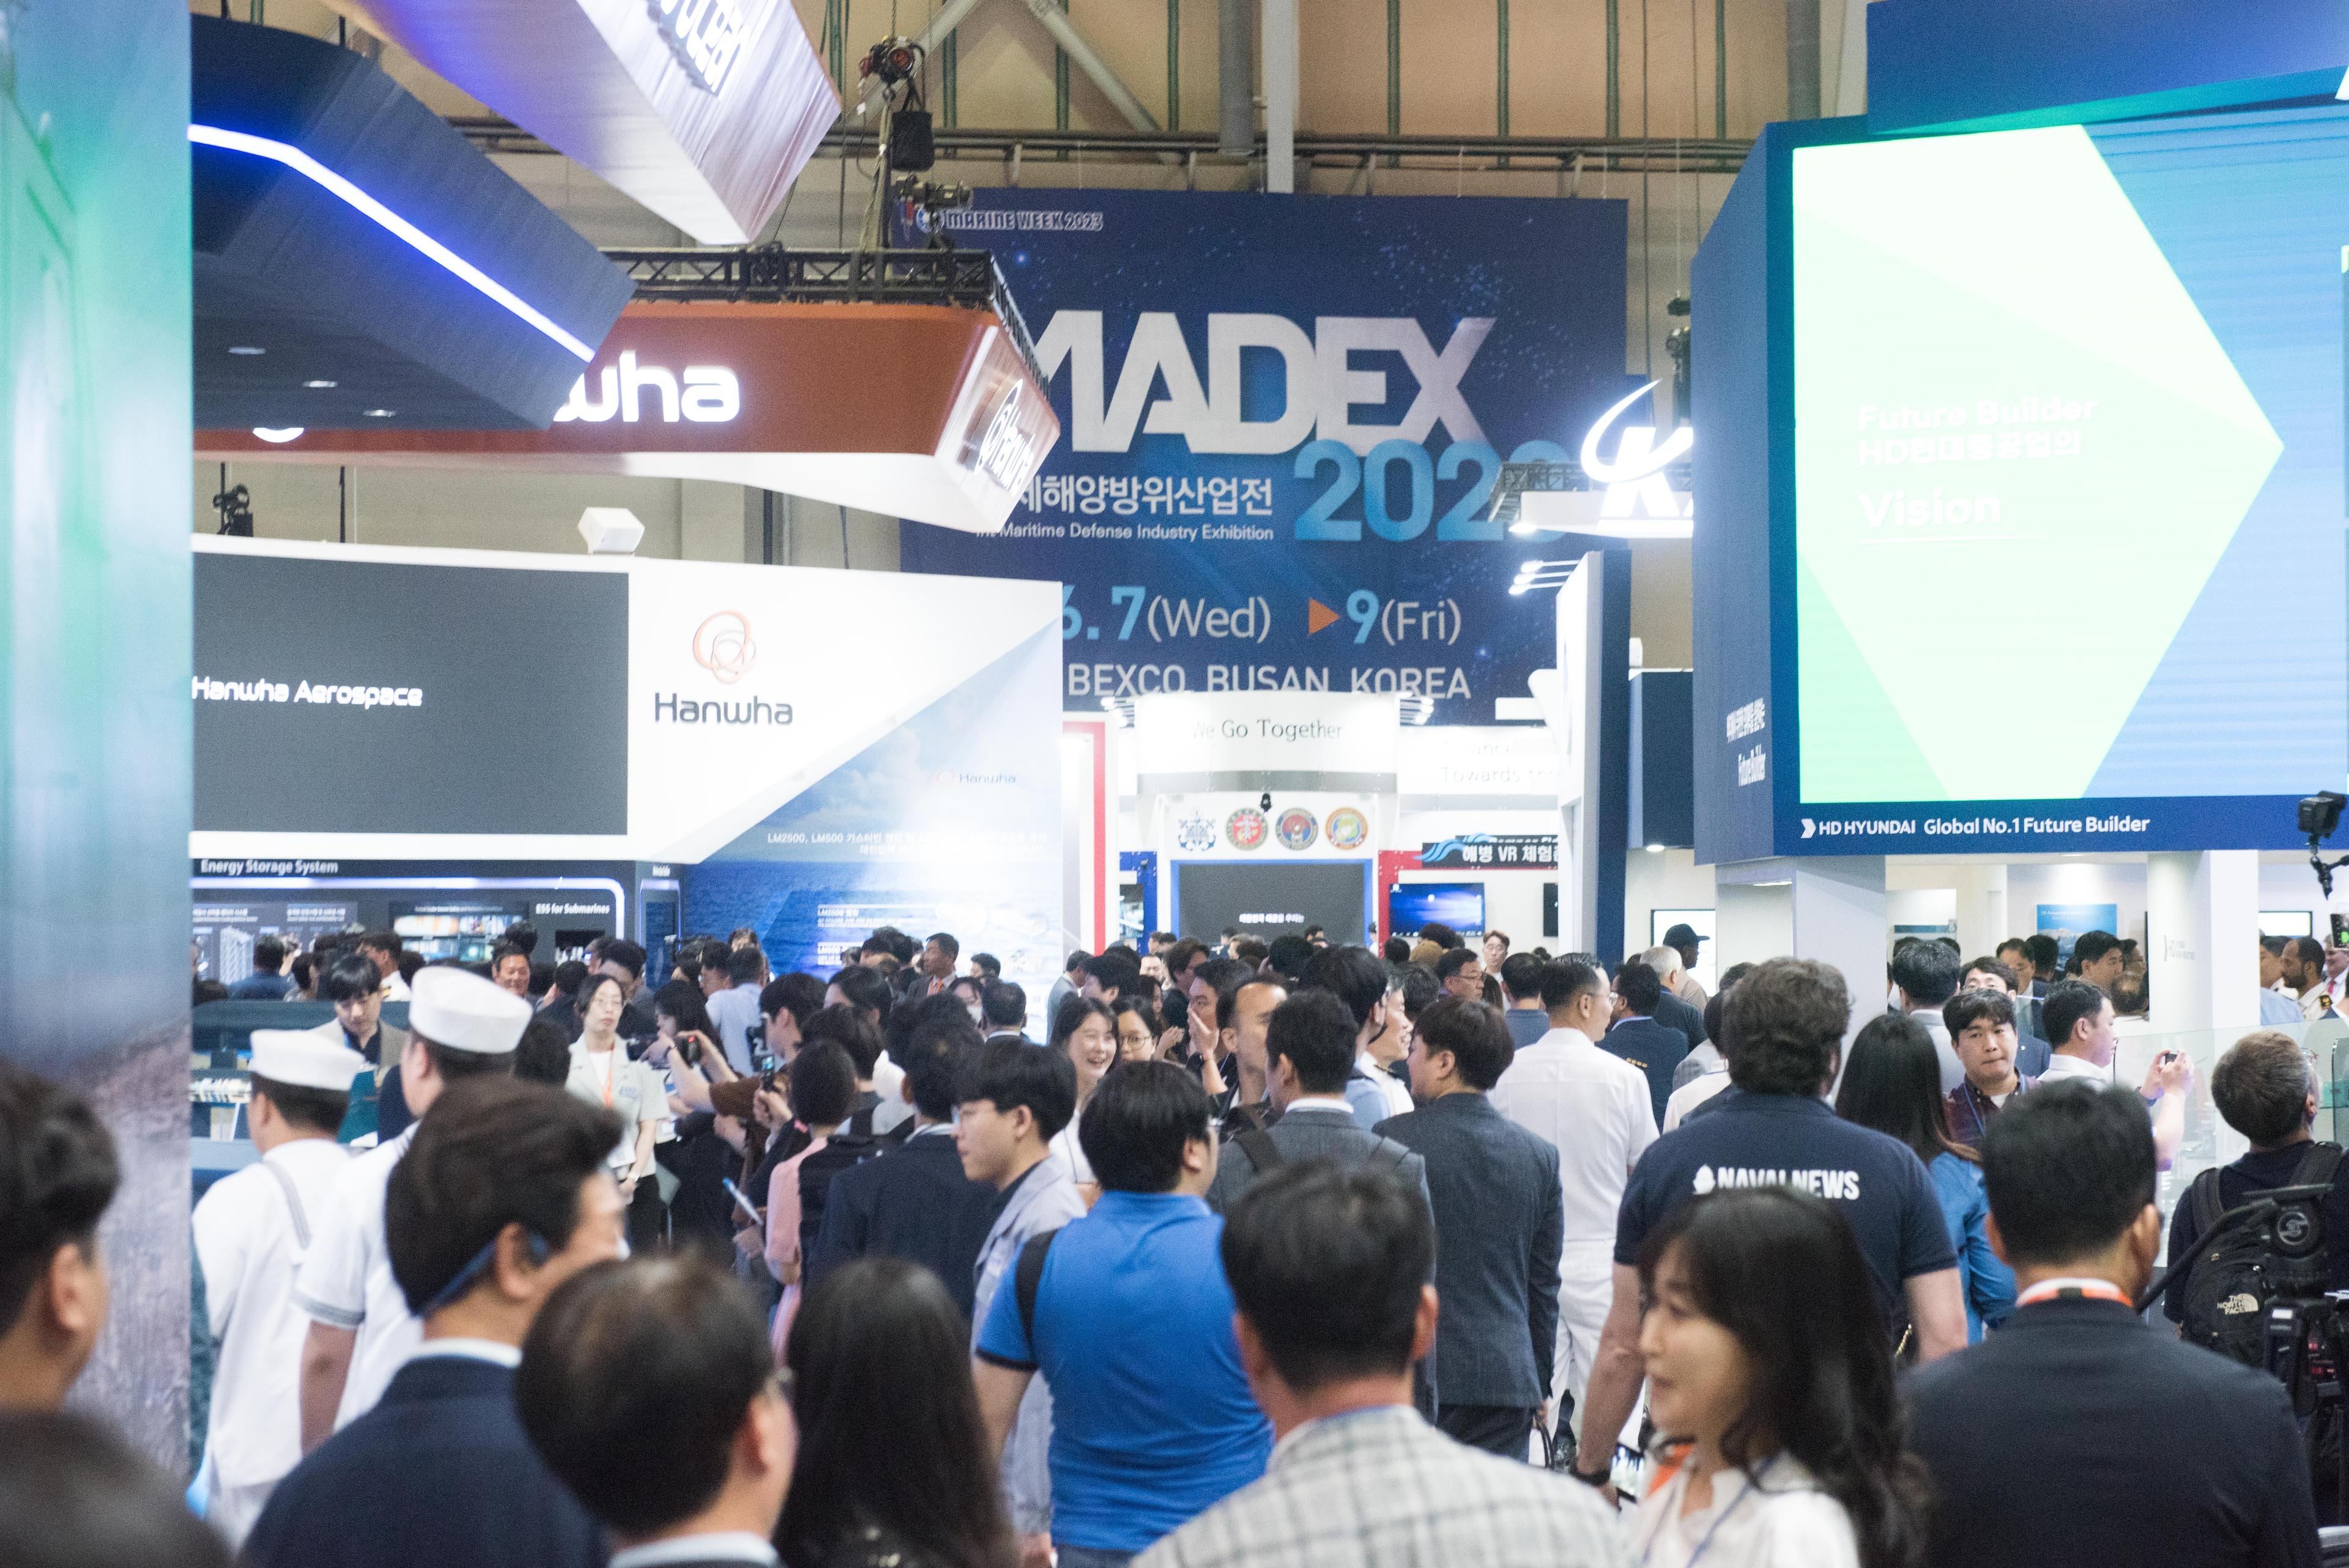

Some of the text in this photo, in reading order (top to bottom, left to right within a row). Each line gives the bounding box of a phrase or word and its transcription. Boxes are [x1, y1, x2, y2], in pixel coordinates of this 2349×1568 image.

[946, 210, 1104, 231] MARINE WEEK 2023
[1034, 310, 1496, 454] MADEX
[1858, 395, 2100, 431] Future Builder
[988, 407, 1035, 497] Hanwha
[1858, 487, 2003, 529] Vision
[998, 522, 1065, 538] Maritime
[1070, 523, 1132, 538] Defense
[1138, 523, 1197, 542] Industry
[1201, 524, 1274, 540] Exhibition
[191, 675, 423, 710] Hanwha Aerospace
[1068, 664, 1471, 699] BEXCO BUSAN KOREA
[655, 693, 793, 724] Hanwha
[1222, 719, 1248, 738] Go
[1256, 719, 1343, 742] Together
[960, 773, 1017, 784] Hanwha
[1819, 816, 2151, 835] HD HYUNDAI Global No.1 Future Builder
[1499, 845, 1518, 861] VR
[201, 859, 339, 876] Energy Storage System
[536, 903, 610, 914] ESS for Submarines
[1792, 1169, 1860, 1200] NEWS
